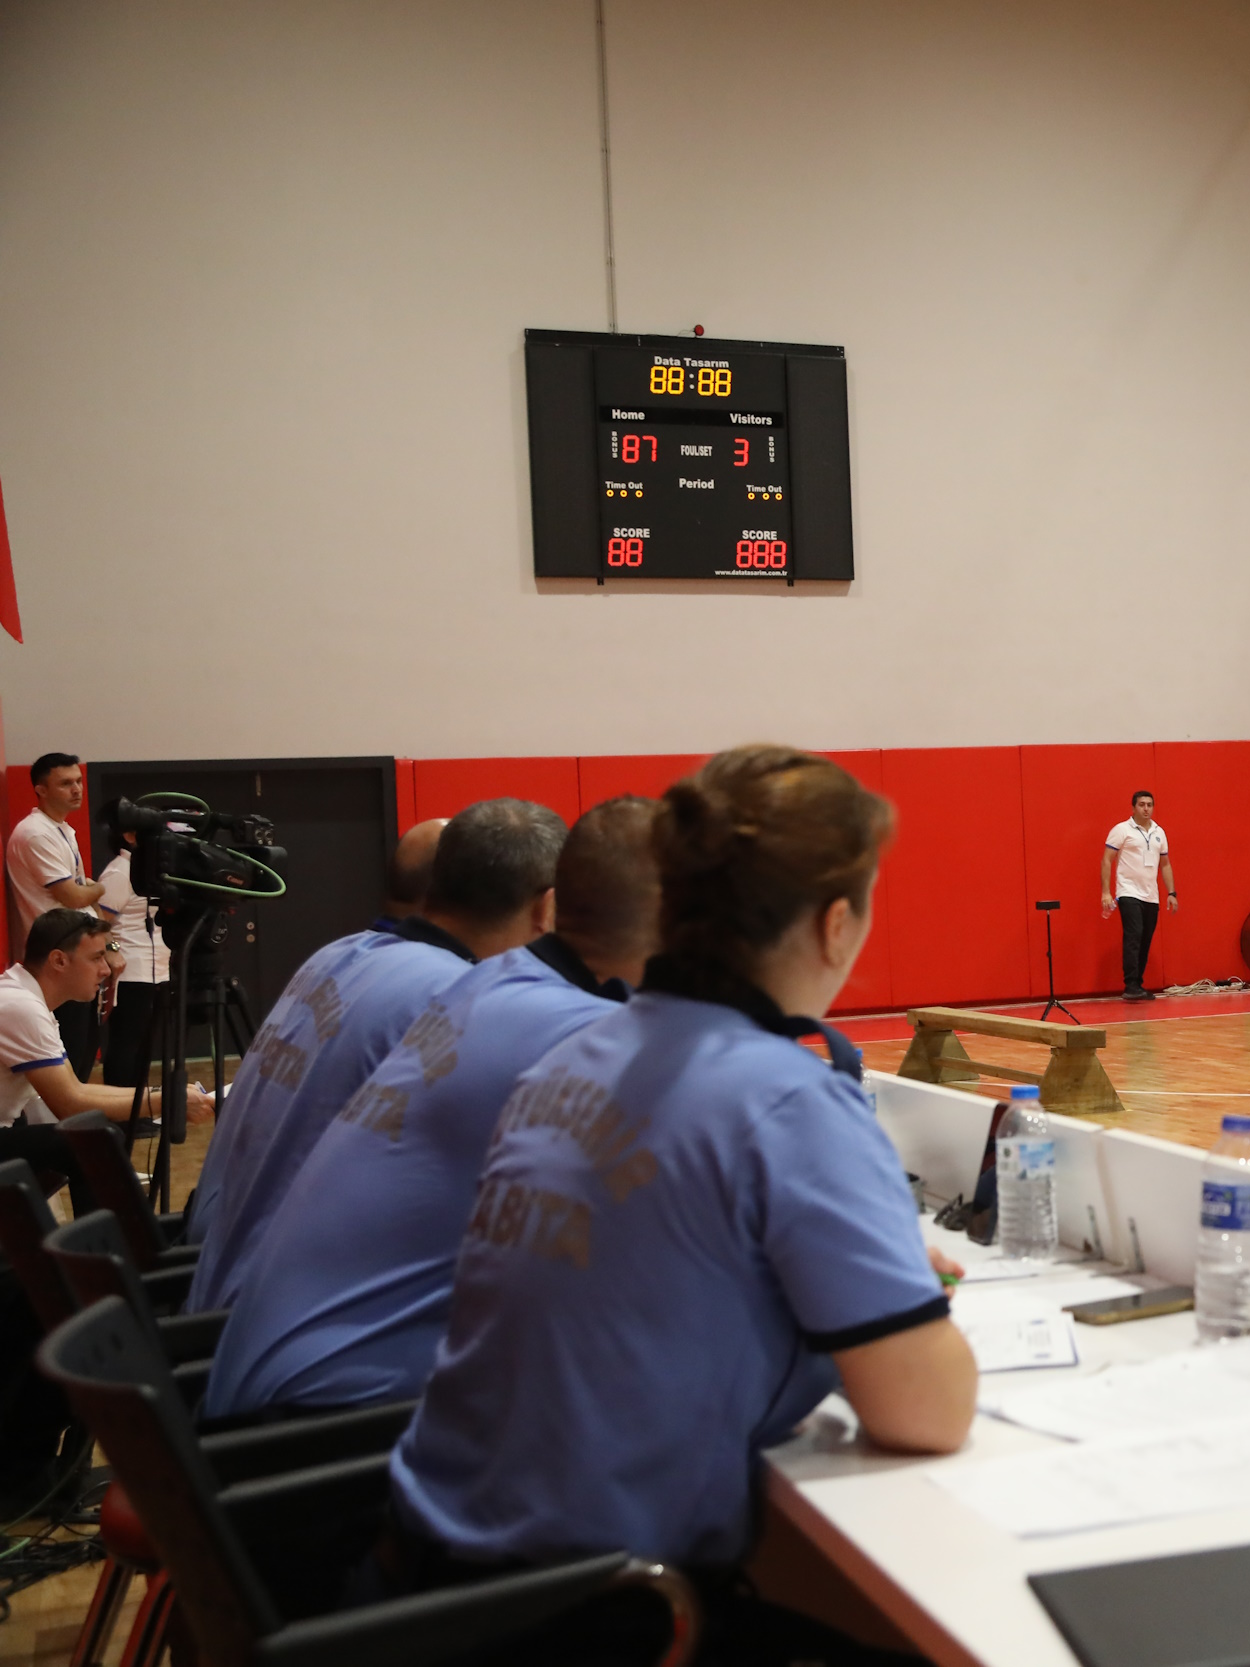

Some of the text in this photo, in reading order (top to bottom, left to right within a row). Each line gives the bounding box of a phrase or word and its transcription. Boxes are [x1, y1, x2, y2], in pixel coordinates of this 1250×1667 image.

[654, 356, 681, 367] Data
[650, 366, 732, 396] 88:88
[612, 409, 645, 420] Home
[730, 413, 772, 425] Visitors
[622, 435, 657, 464] 87
[733, 438, 749, 466] 3
[605, 481, 643, 490] Time Out
[679, 478, 715, 490] Period
[746, 485, 782, 493] Time Out
[613, 528, 650, 538] SCORE
[742, 530, 777, 540] SCORE
[607, 538, 643, 567] 88
[736, 540, 787, 569] 888
